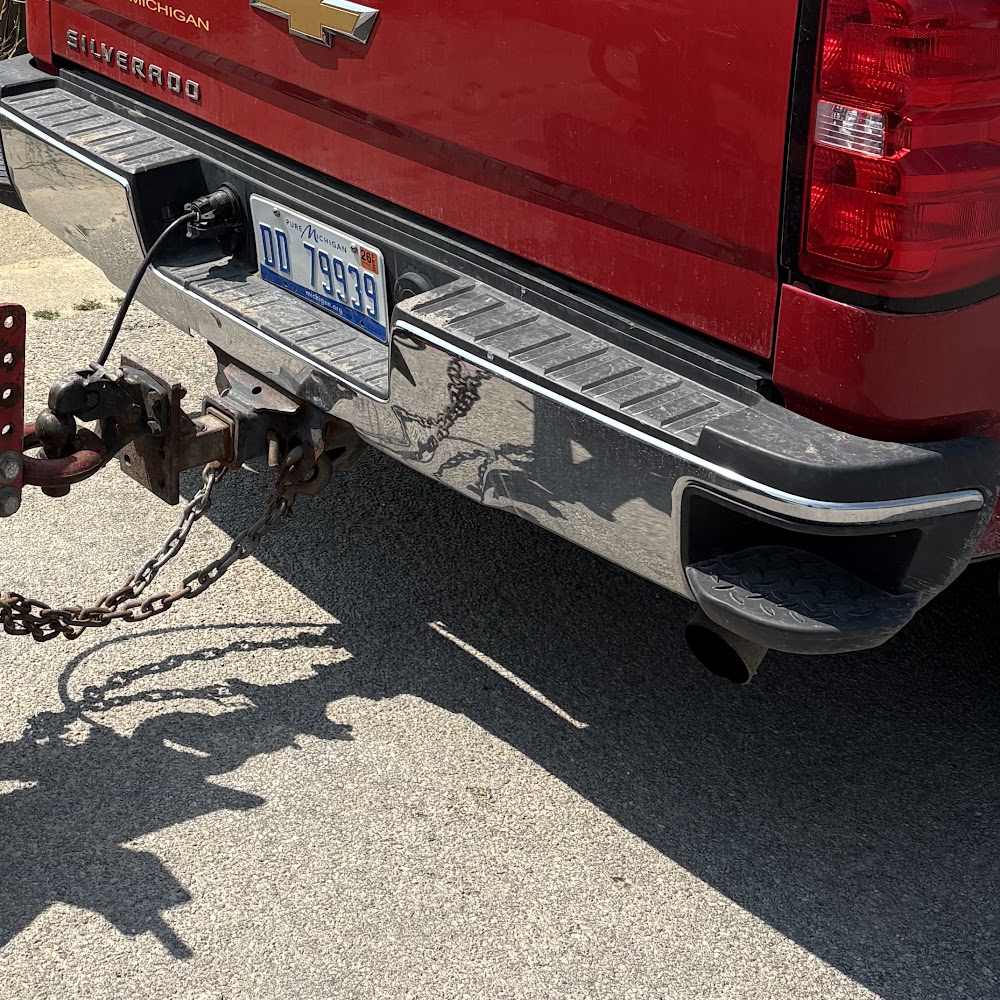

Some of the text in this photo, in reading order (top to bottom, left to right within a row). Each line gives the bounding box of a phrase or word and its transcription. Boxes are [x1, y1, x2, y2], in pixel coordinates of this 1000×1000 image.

[66, 28, 201, 102] SILVERADO
[285, 218, 303, 233] PURE
[258, 221, 378, 320] DD 79939
[305, 290, 343, 315] michigan.org
